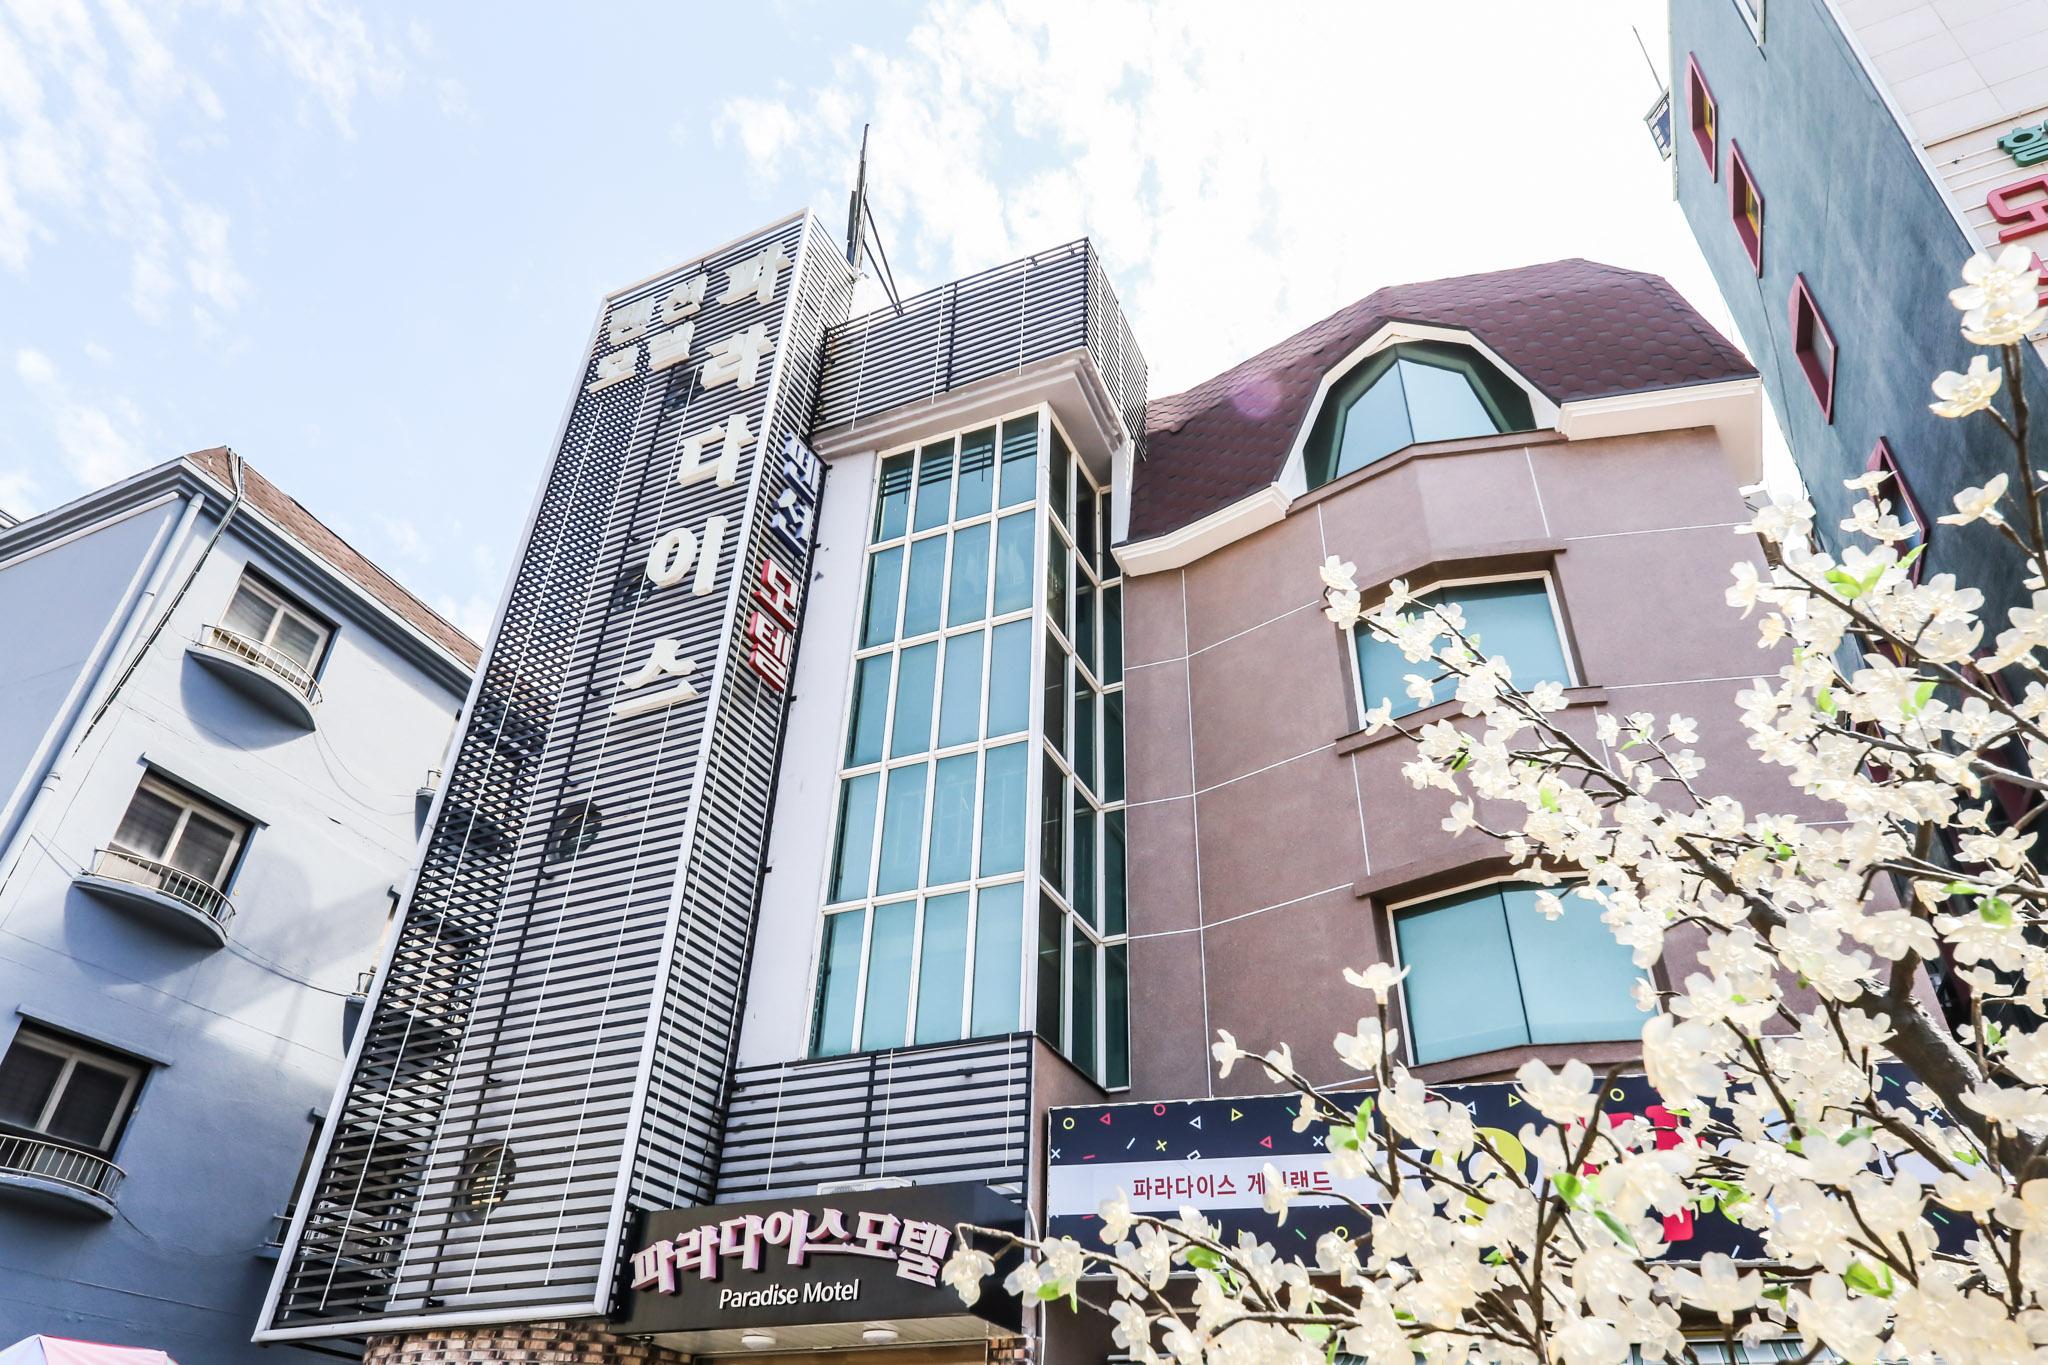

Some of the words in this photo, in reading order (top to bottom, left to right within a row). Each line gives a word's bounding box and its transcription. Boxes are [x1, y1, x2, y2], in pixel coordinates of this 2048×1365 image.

[587, 321, 696, 393] 모텔
[609, 243, 791, 718] 파라다이스
[772, 431, 820, 557] 펜션
[748, 558, 798, 692] 모텔
[1133, 1174, 1236, 1200] 파라다이스
[1247, 1170, 1333, 1195] 게랜드
[630, 1208, 952, 1295] 파라다이스모텔
[719, 1283, 797, 1309] Paradise
[802, 1278, 860, 1304] Motel
